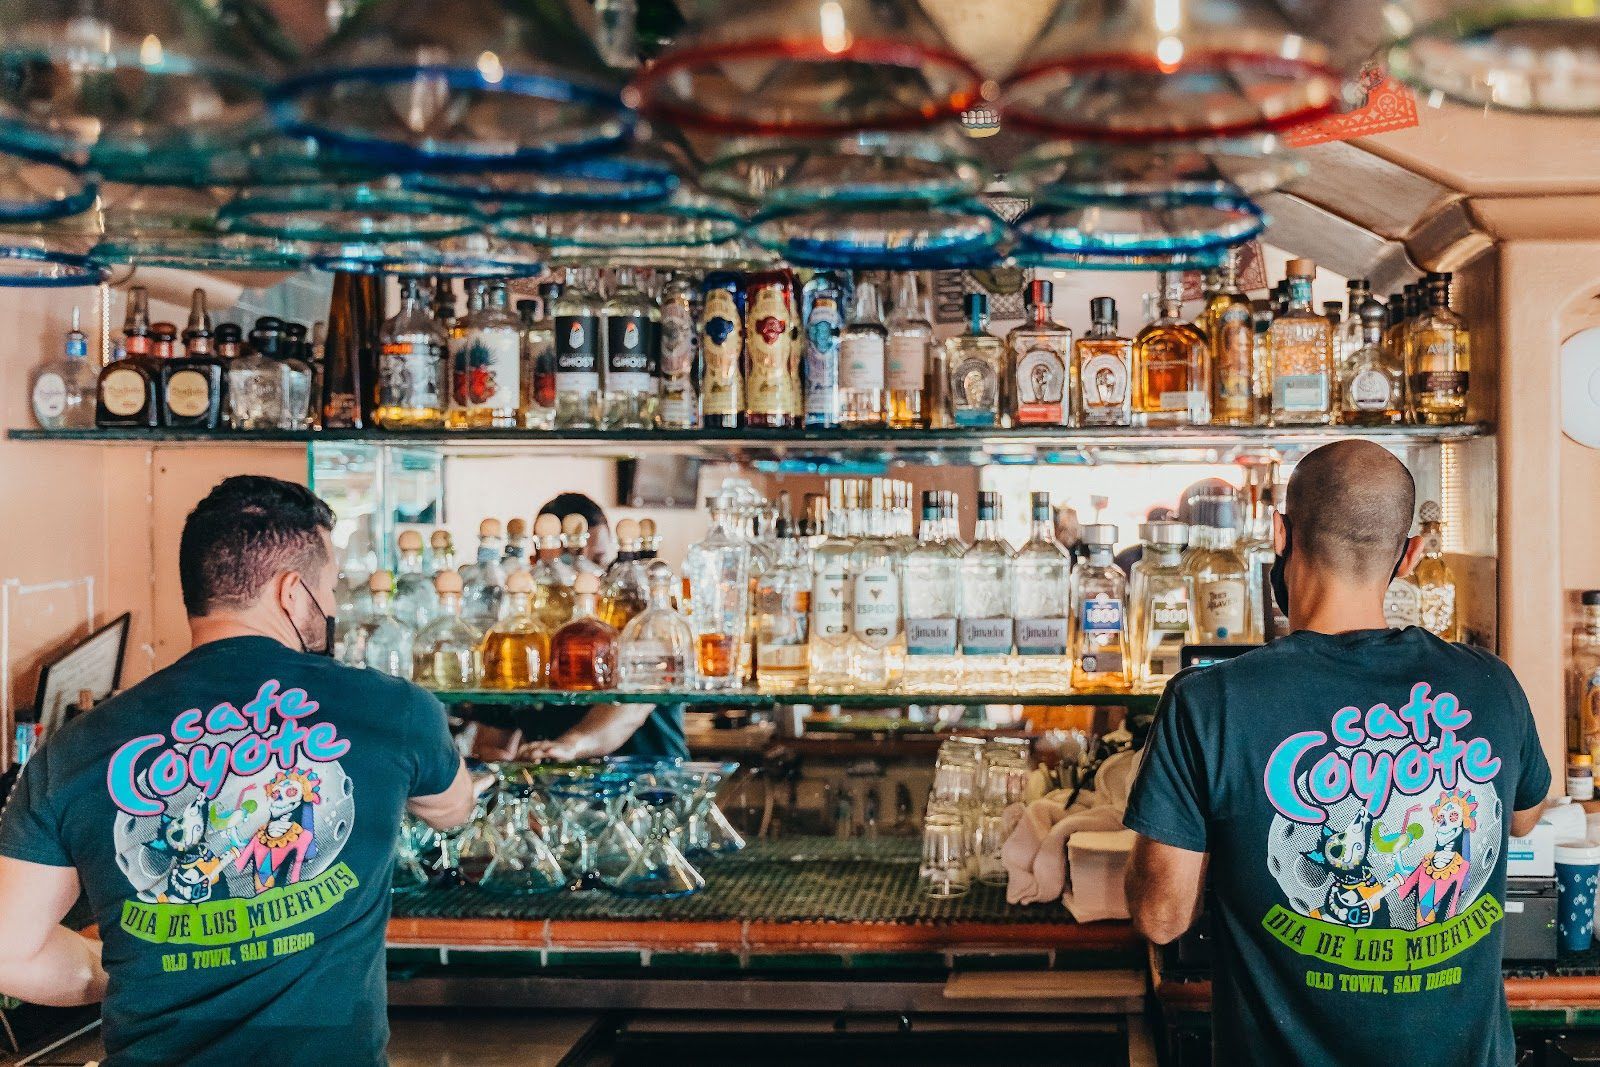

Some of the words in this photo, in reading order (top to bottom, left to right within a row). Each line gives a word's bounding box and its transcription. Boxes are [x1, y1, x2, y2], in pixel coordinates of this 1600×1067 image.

[559, 356, 594, 368] GHOST
[612, 356, 647, 368] GHOST
[171, 679, 319, 743] cafe
[1331, 681, 1472, 746] cafe
[107, 718, 351, 817] Coyote
[1263, 730, 1501, 824] Coyote
[125, 906, 157, 935] DIA
[168, 914, 191, 938] DE
[201, 909, 237, 937] LOS
[246, 866, 354, 928] MUERTOS
[1267, 910, 1307, 946] DIA
[1315, 933, 1345, 959] DE
[1354, 938, 1393, 962] LOS
[1405, 899, 1499, 962] MUERTOS
[162, 954, 187, 972] OLD
[240, 941, 267, 962] SAN
[273, 932, 315, 956] DIEGO
[1306, 970, 1333, 989] OLD
[1393, 974, 1422, 994] SAN
[1425, 966, 1462, 991] DIEGO
